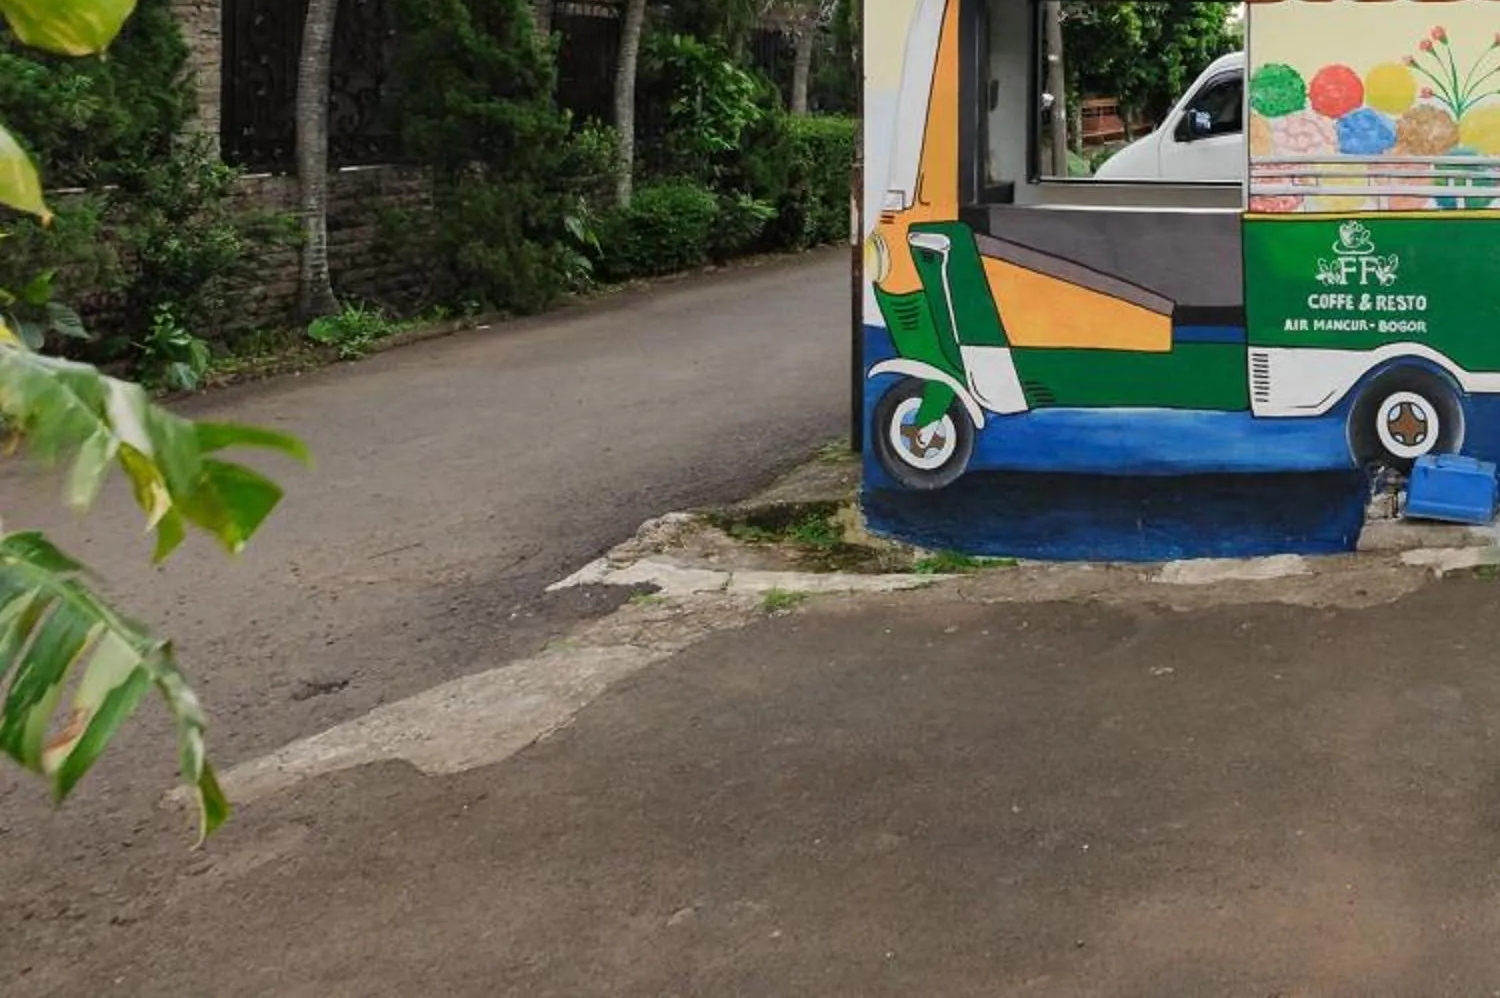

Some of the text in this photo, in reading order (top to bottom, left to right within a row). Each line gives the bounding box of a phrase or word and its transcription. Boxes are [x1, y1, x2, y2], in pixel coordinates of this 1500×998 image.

[1338, 255, 1380, 285] FF
[1307, 293, 1427, 311] COFFE & RESTO
[1284, 318, 1308, 331] AIR
[1377, 320, 1428, 333] BOGOR
